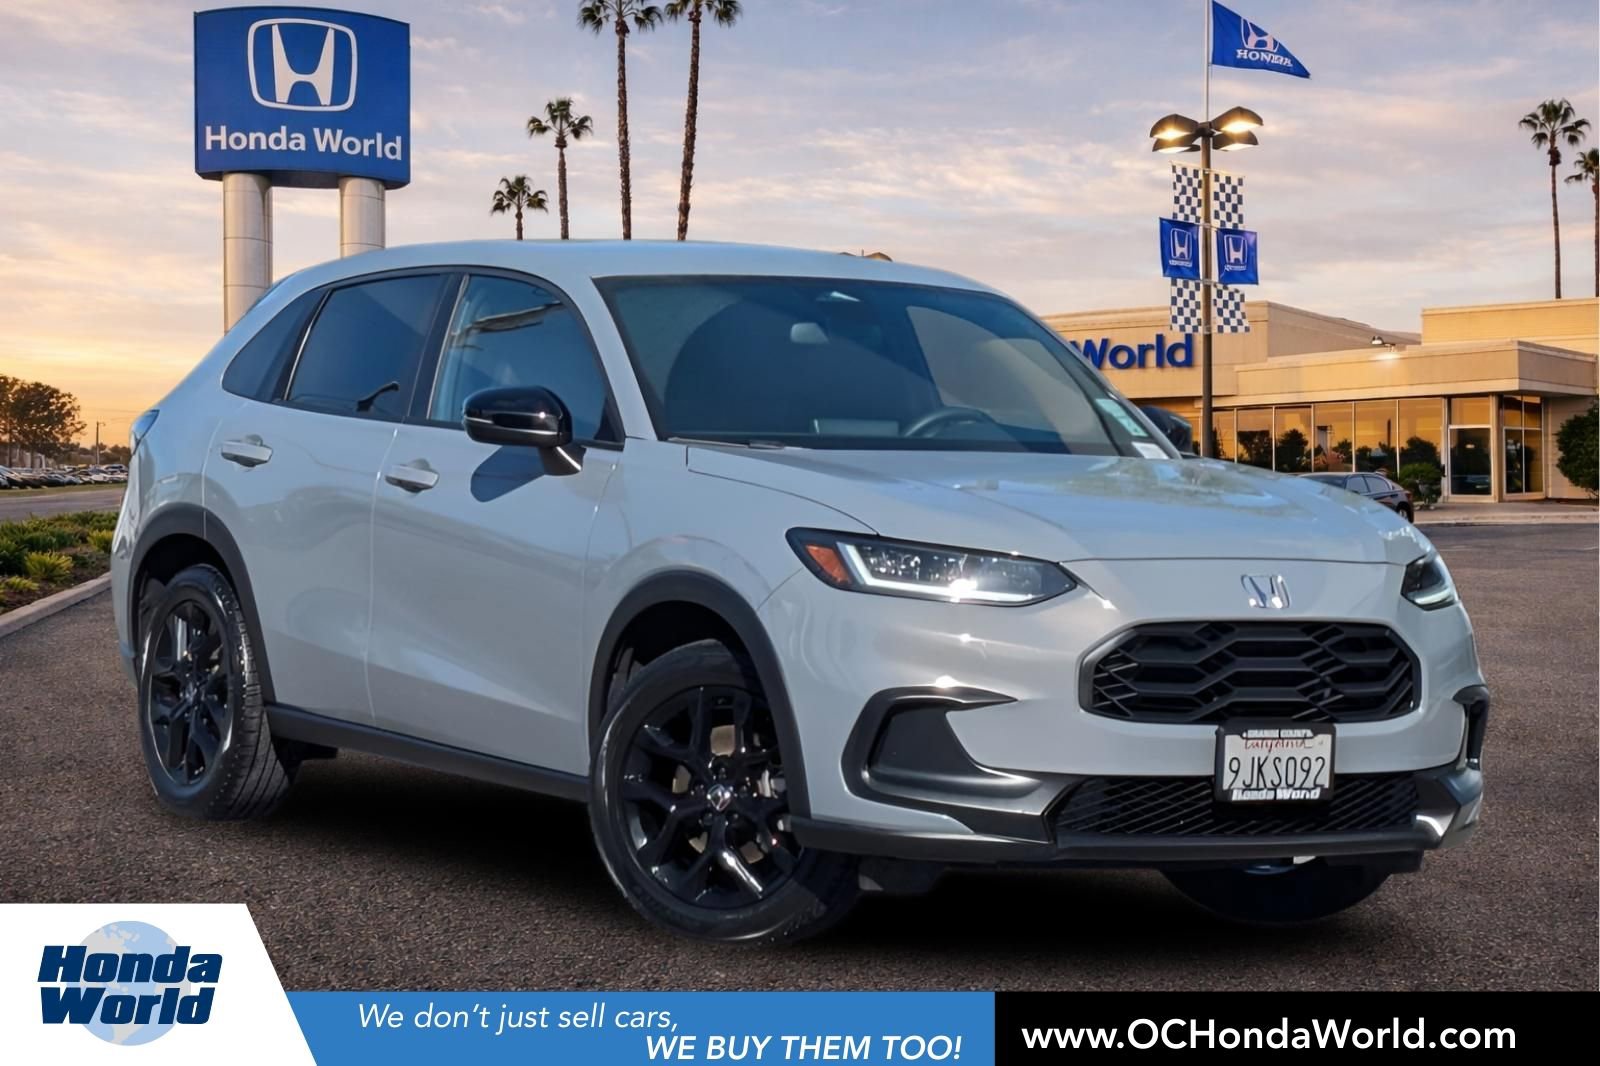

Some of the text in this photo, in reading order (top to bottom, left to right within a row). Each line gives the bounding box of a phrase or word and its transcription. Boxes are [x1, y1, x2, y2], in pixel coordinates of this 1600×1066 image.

[206, 126, 402, 161] Honda World
[1229, 756, 1326, 789] 9JKS092
